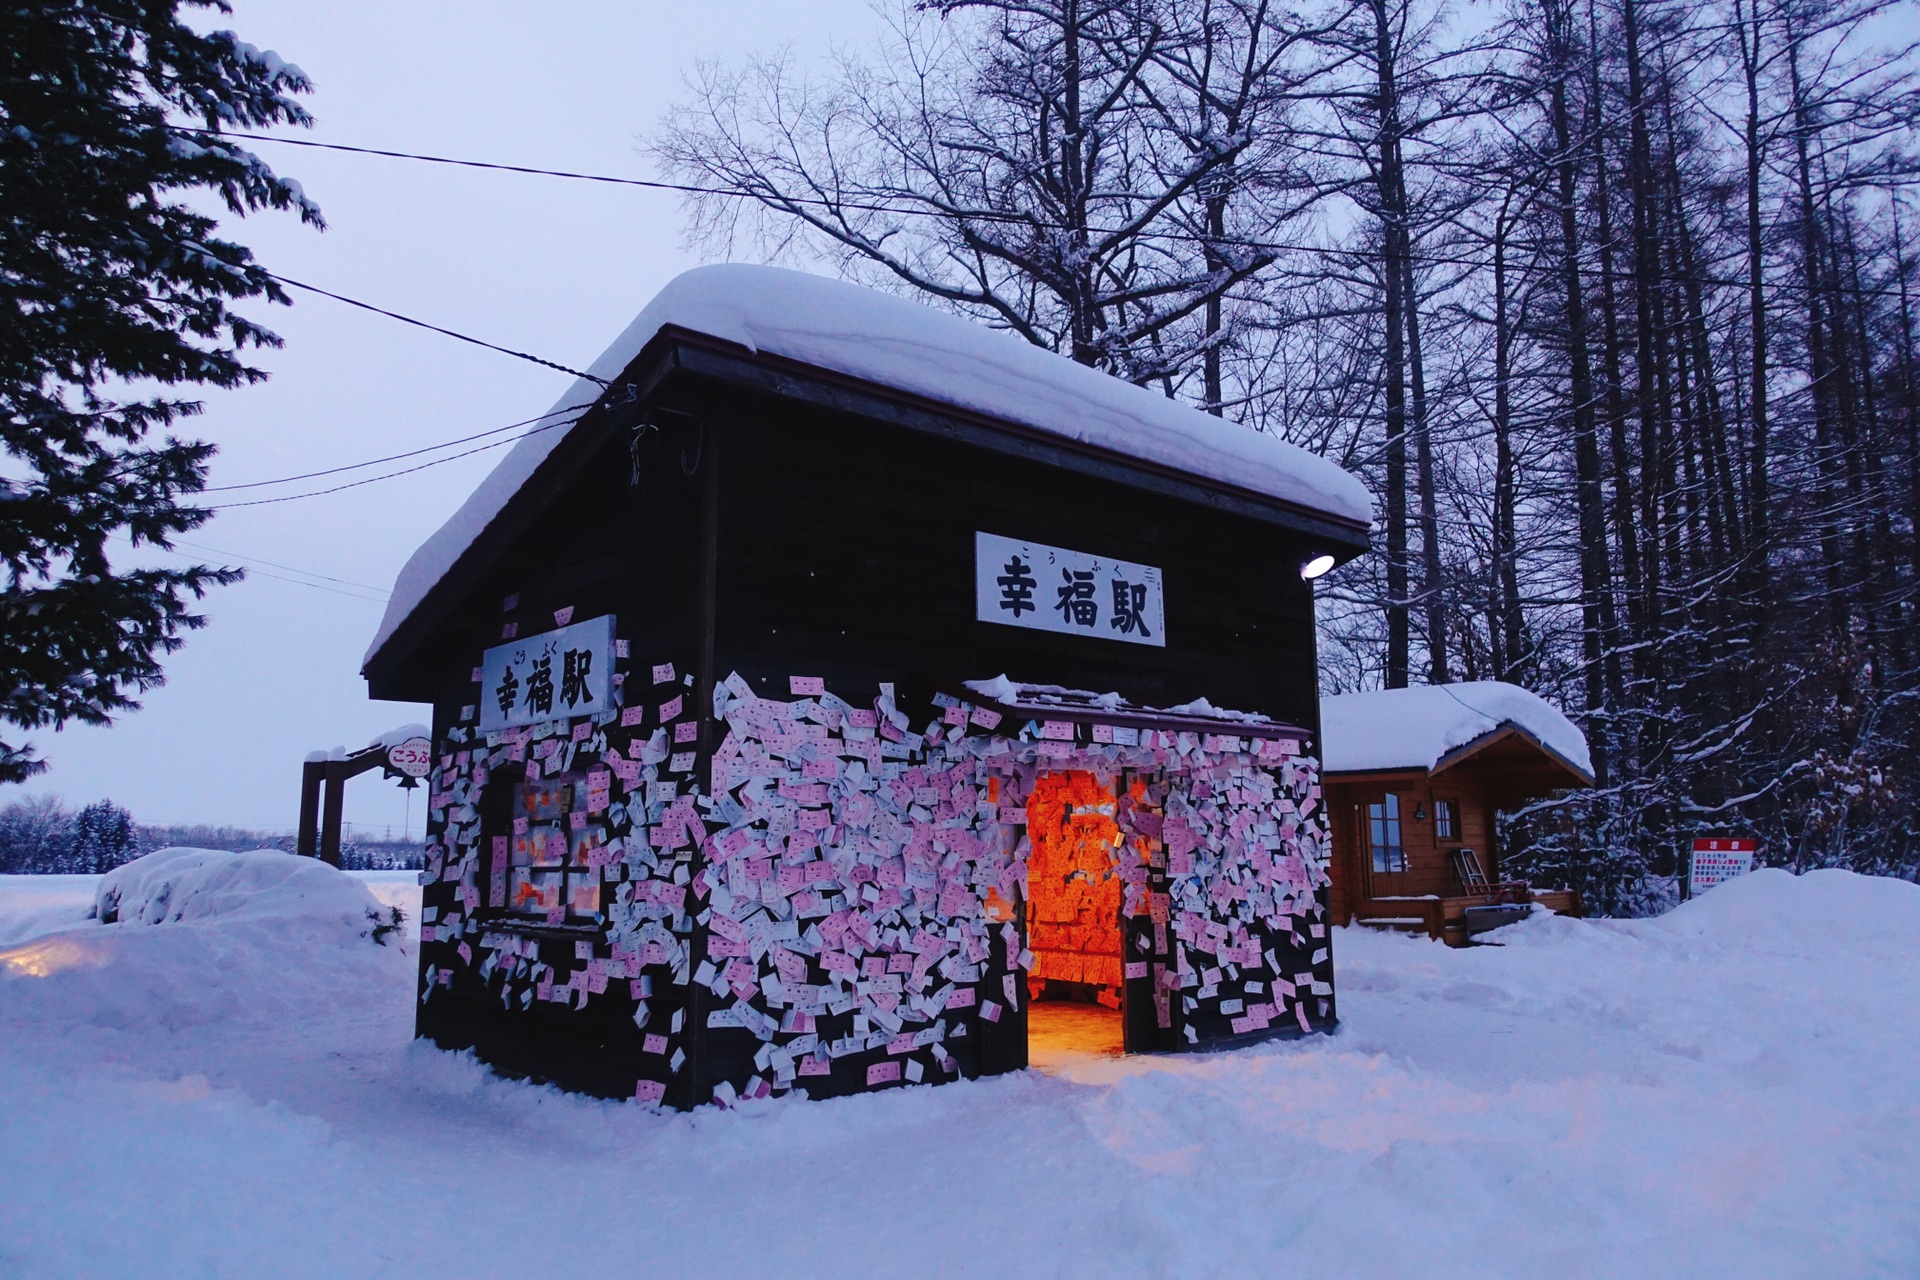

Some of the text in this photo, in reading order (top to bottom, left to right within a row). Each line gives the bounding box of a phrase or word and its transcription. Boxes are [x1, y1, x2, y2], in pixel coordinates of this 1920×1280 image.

[1022, 547, 1123, 578] こうふく
[997, 554, 1151, 637] 幸福駅
[514, 640, 557, 665] こうふく
[496, 648, 593, 721] 幸福駅
